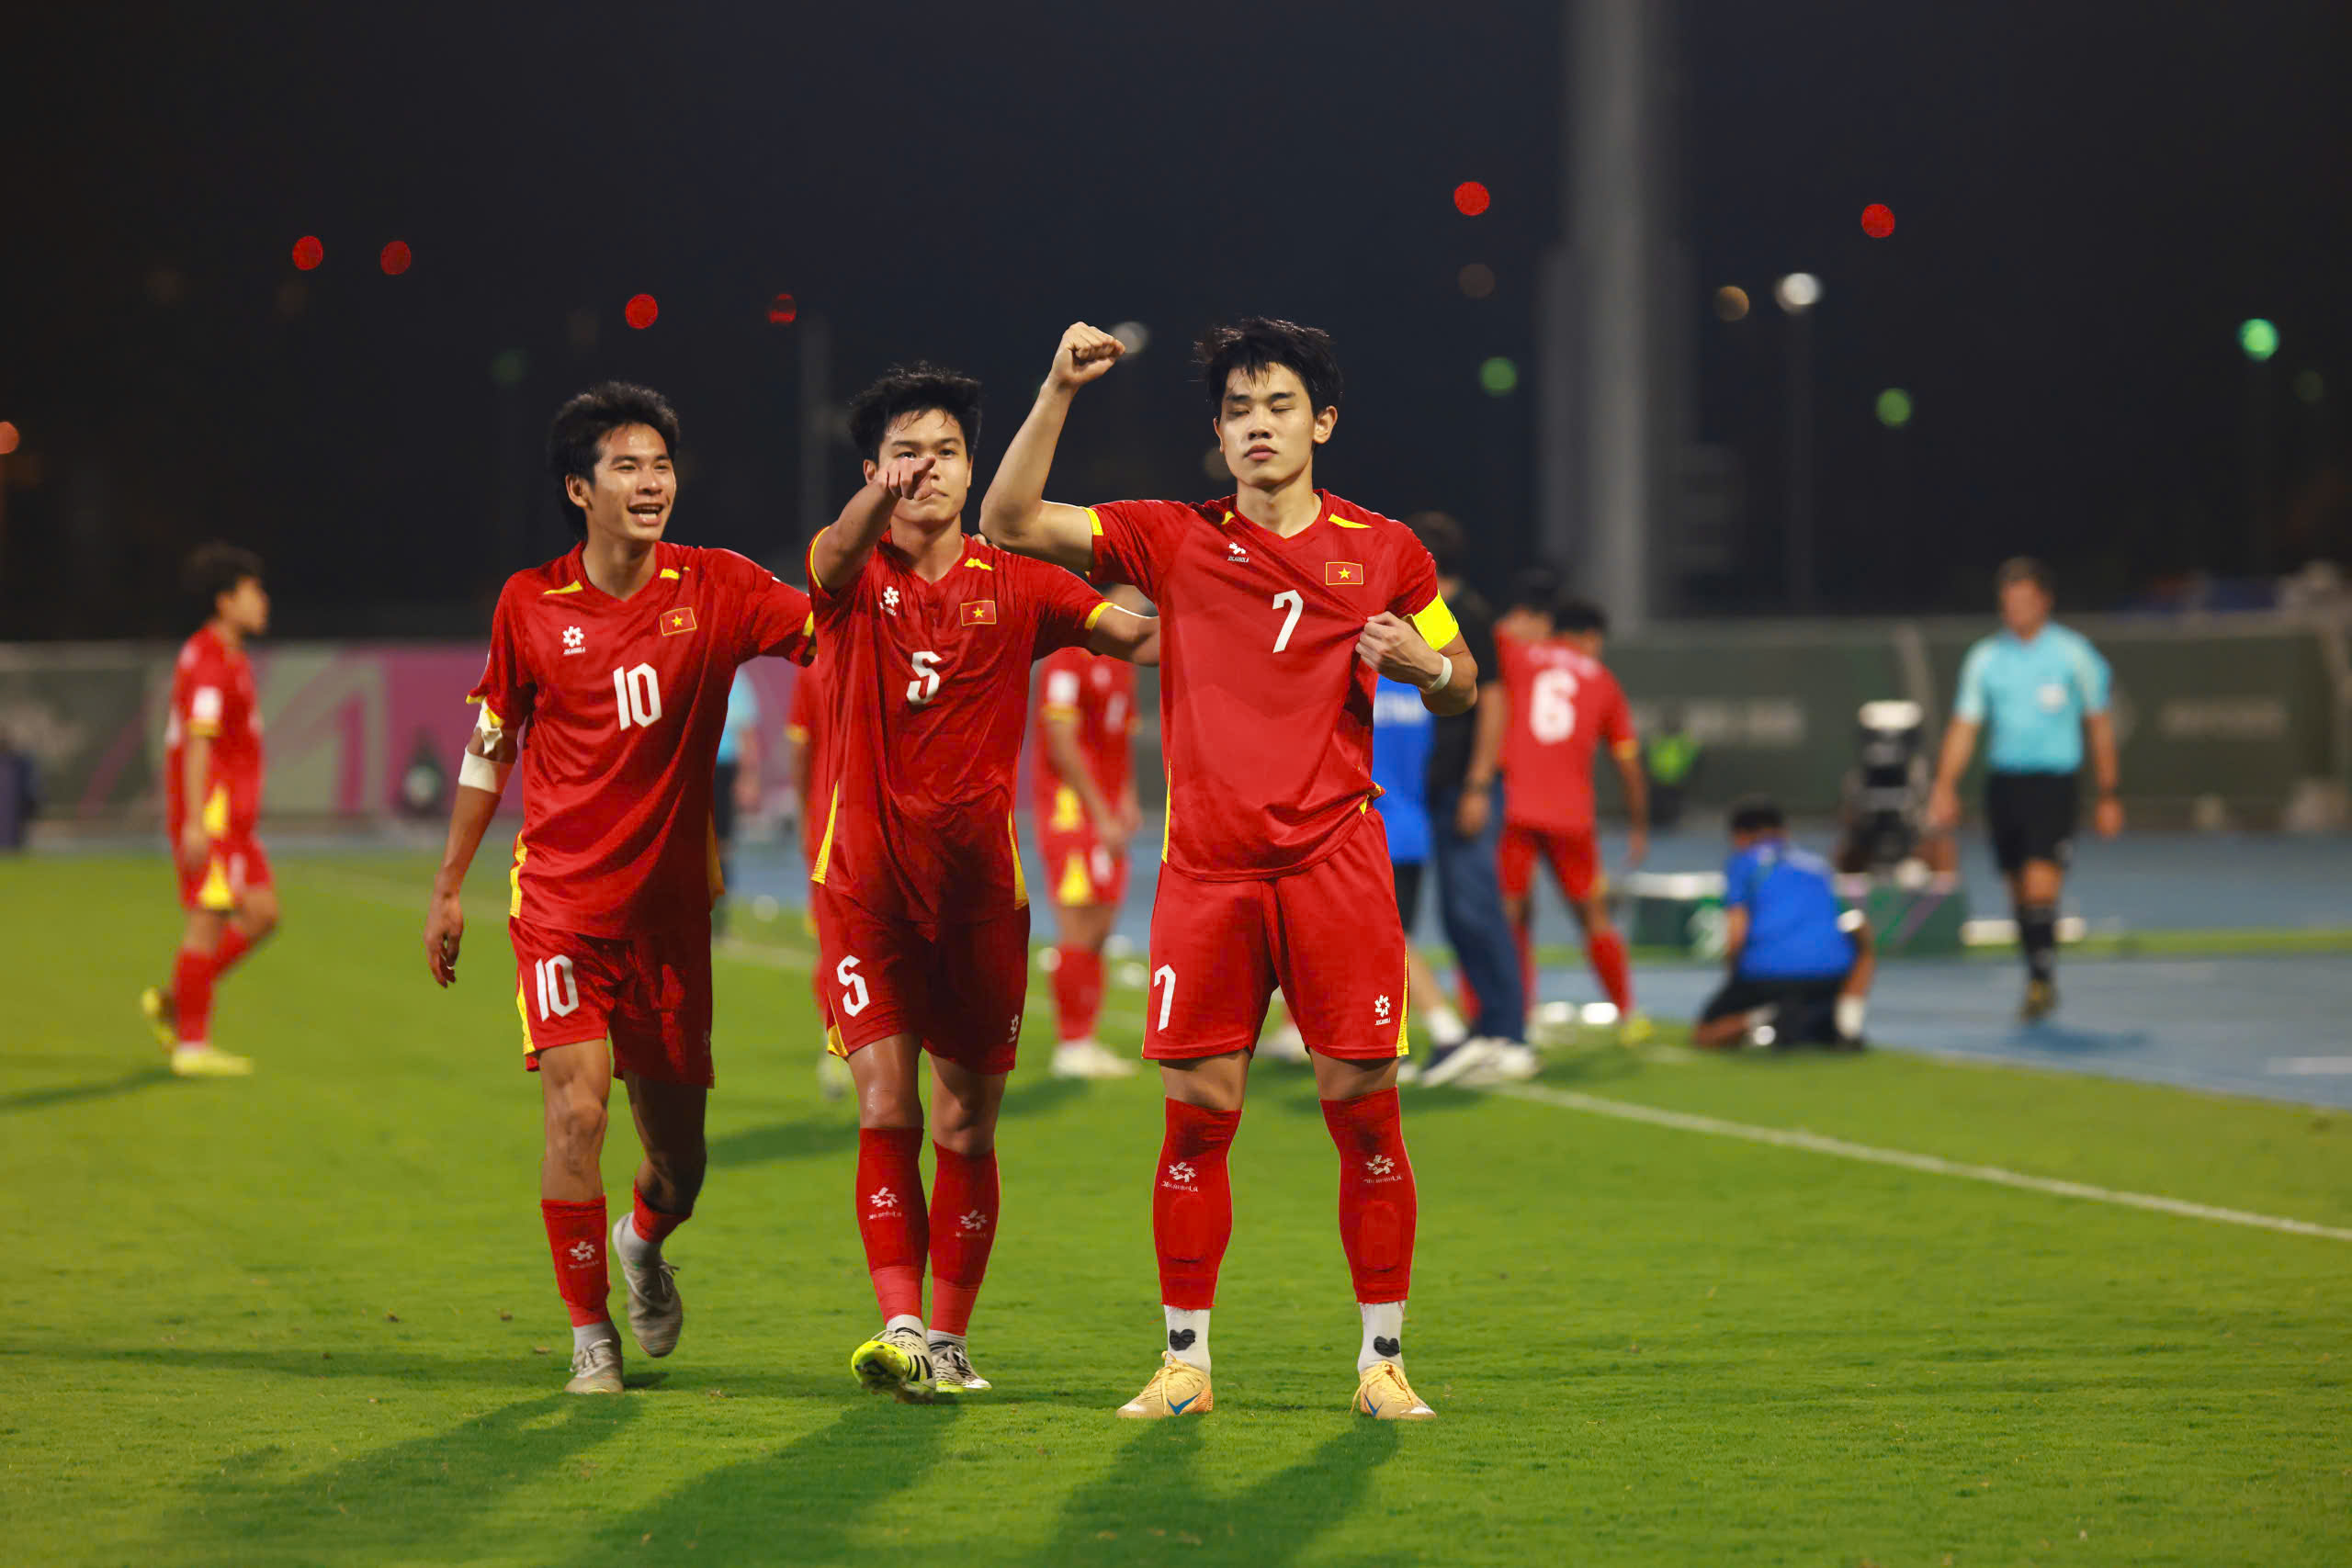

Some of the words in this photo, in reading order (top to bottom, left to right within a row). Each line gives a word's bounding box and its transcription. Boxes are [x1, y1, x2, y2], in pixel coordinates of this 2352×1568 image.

[1272, 590, 1304, 654] 7
[613, 662, 662, 732] 10
[906, 650, 943, 705] 5
[1530, 669, 1578, 745] 6
[535, 953, 580, 1022] 10
[836, 954, 870, 1018] 5
[1154, 964, 1177, 1032] 7
